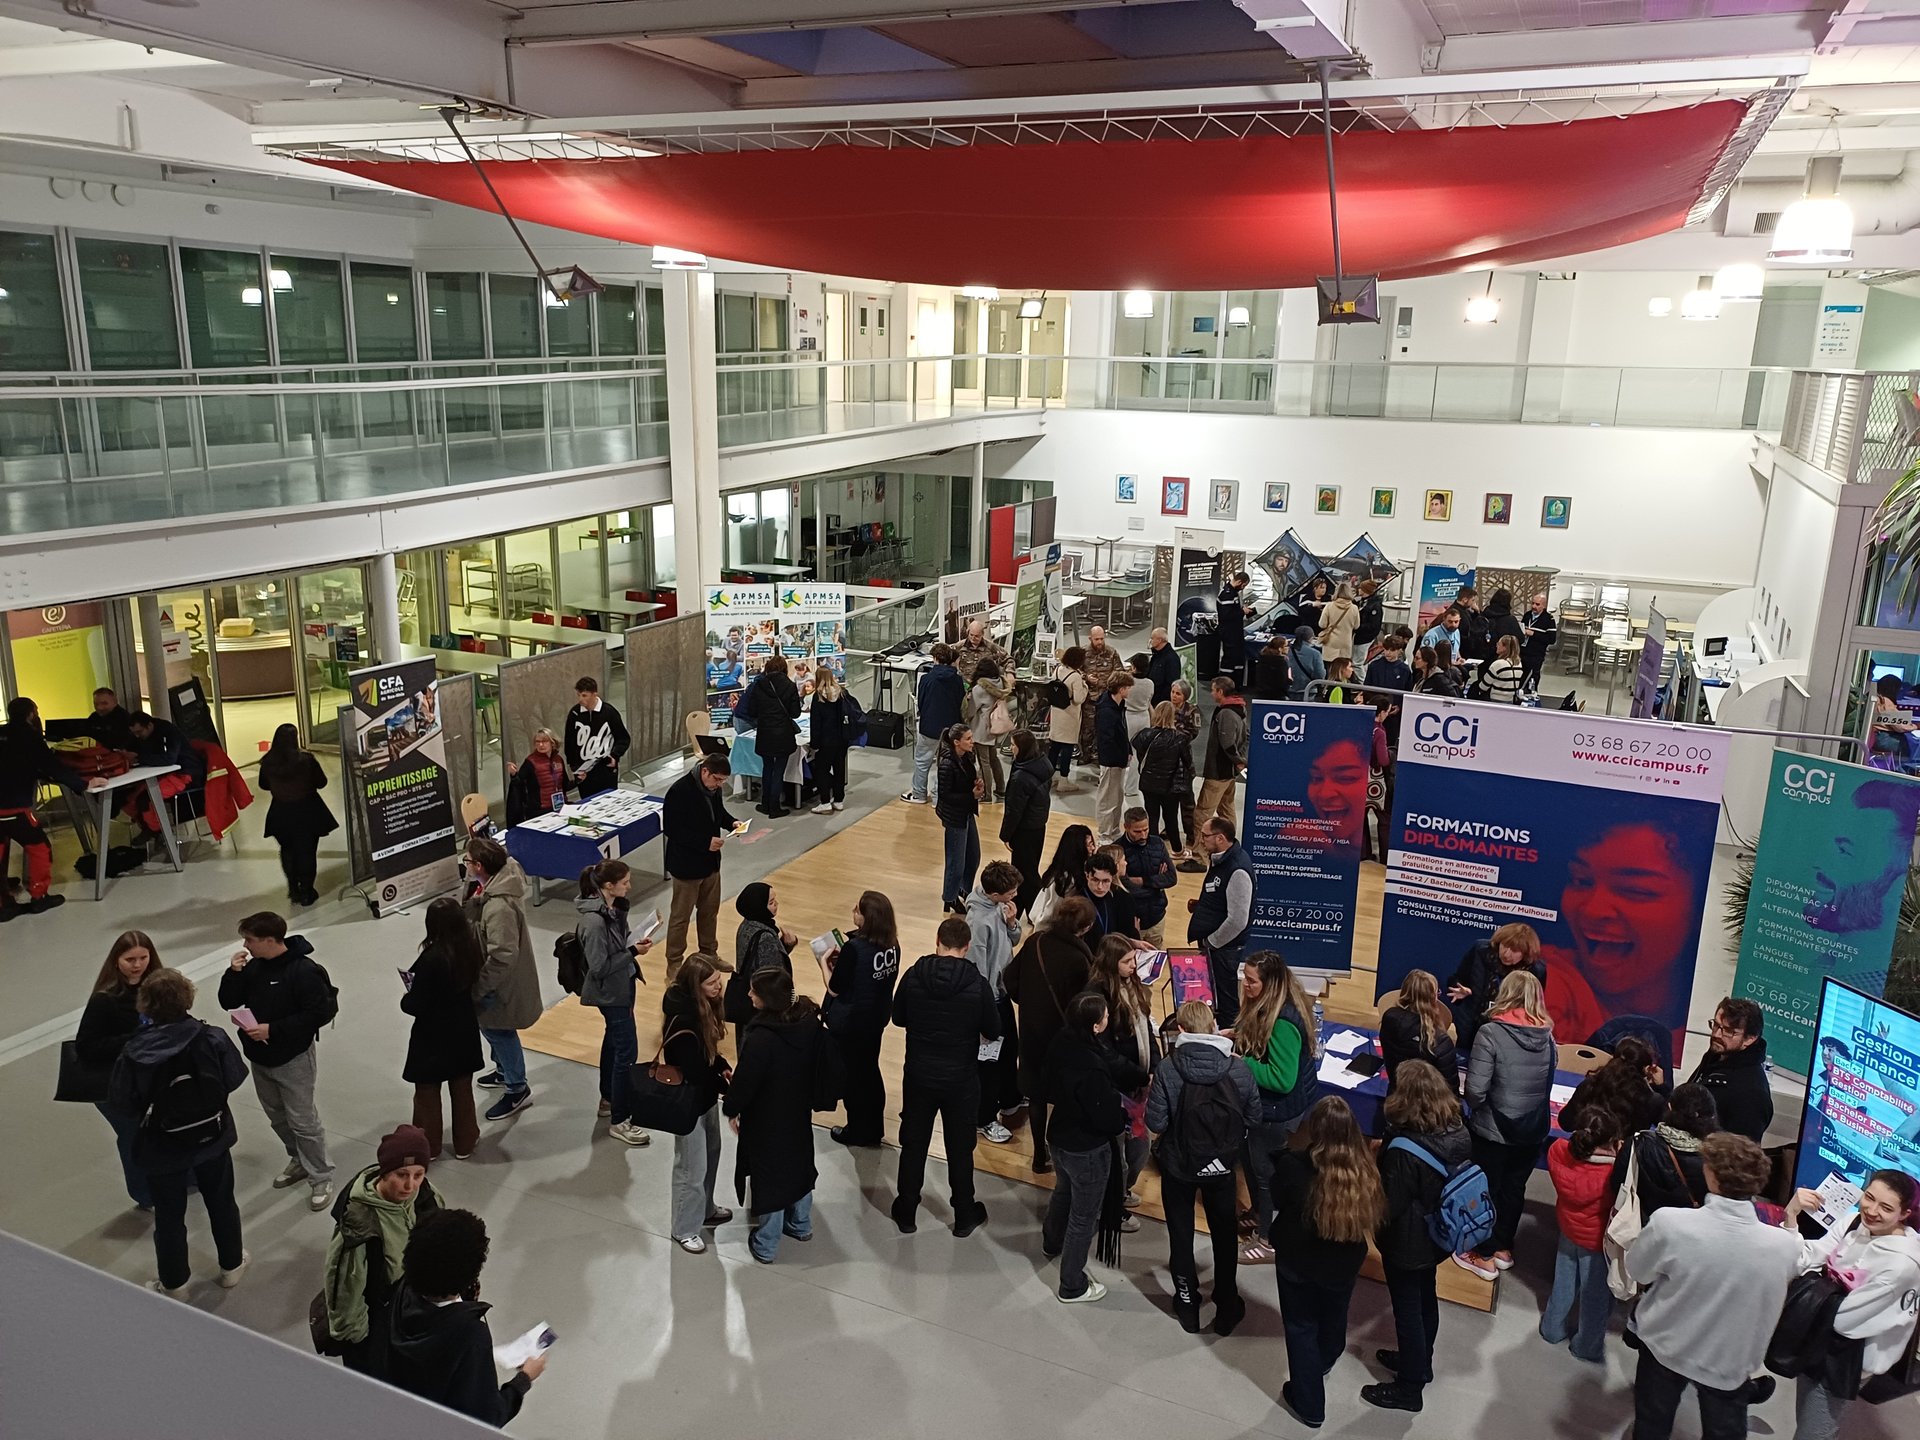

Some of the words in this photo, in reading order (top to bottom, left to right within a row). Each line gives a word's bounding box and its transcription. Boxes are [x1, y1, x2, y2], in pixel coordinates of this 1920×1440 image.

[805, 592, 841, 600] APMSA
[960, 601, 986, 617] APPRENDRE
[379, 675, 404, 690] CFA
[1262, 733, 1304, 744] campus
[1573, 733, 1596, 748] 03
[1602, 737, 1623, 751] 68
[1630, 740, 1651, 754] 67
[1656, 743, 1680, 757] 20
[1686, 746, 1711, 761] 00
[1413, 742, 1476, 760] campus
[1572, 750, 1709, 775] www.ccicampus.fr
[367, 765, 438, 798] APPRENTISSAGE
[385, 793, 396, 801] BAC
[1257, 799, 1301, 807] FORMATIONS
[1782, 787, 1831, 805] campus
[1255, 815, 1292, 823] FORMATIONS
[1405, 812, 1531, 844] FORMATIONS
[377, 848, 395, 858] AVENIR
[401, 836, 430, 849] FORMATION
[604, 845, 611, 859] 1
[1253, 845, 1291, 853] STRASBOURG
[1403, 829, 1539, 863] DIPLÔMANTES
[1401, 860, 1433, 872] gratuites
[1435, 865, 1443, 873] et
[1444, 867, 1488, 880] rémunérées
[1402, 852, 1443, 865] Formations
[1455, 861, 1497, 875] alternance,
[1291, 871, 1343, 880] D'APPRENTISSAGE
[1400, 873, 1423, 882] Bac+2
[1430, 878, 1462, 890] Bachelor
[1470, 885, 1493, 895] Bac+5
[1501, 890, 1519, 899] MBA
[1766, 877, 1816, 897] DIPLÔMANT
[1255, 905, 1264, 915] 3
[1268, 906, 1284, 917] 68
[1287, 908, 1302, 918] 67
[1305, 909, 1322, 920] 20
[1325, 911, 1344, 921] 00
[1398, 900, 1443, 914] CONSULTEZ
[1444, 908, 1461, 917] NOS
[1462, 911, 1494, 922] OFFRES
[1399, 887, 1439, 900] Strasbourg
[1446, 894, 1475, 906] Sélestat
[1483, 901, 1510, 911] Colmar
[1518, 906, 1554, 919] Mulhouse
[1761, 902, 1819, 925] ALTERNANCE
[1802, 896, 1821, 908] BAC
[1830, 904, 1837, 912] 5
[1397, 907, 1408, 915] DE
[1409, 910, 1450, 923] CONTRATS
[1757, 926, 1763, 934] &
[1764, 929, 1826, 954] CERTIFIANTES
[1828, 949, 1853, 962] (CPF)
[1758, 918, 1815, 941] FORMATIONS
[1816, 936, 1859, 955] COURTES
[1754, 943, 1794, 961] LANGUES
[1752, 951, 1809, 975] ÉTRANGÈRES
[1746, 981, 1765, 997] 03
[1769, 989, 1788, 1005] 68
[1792, 998, 1810, 1011] 67
[1854, 1030, 1913, 1067] Gestion
[1835, 1057, 1850, 1070] Bac
[1853, 1066, 1863, 1075] +2
[1855, 1048, 1916, 1087] Finance
[1830, 1088, 1845, 1101] Bac
[1847, 1097, 1857, 1106] +3
[1831, 1077, 1866, 1100] Gestion
[1832, 1066, 1851, 1081] BTS
[1853, 1077, 1913, 1113] Comptabilité
[1826, 1108, 1838, 1119] de
[1840, 1116, 1880, 1141] Business
[1881, 1137, 1901, 1153] Unit
[1828, 1097, 1868, 1124] Bachelor
[1869, 1119, 1920, 1152] Responsab
[1820, 1148, 1835, 1161] Bac
[1837, 1157, 1846, 1168] +5
